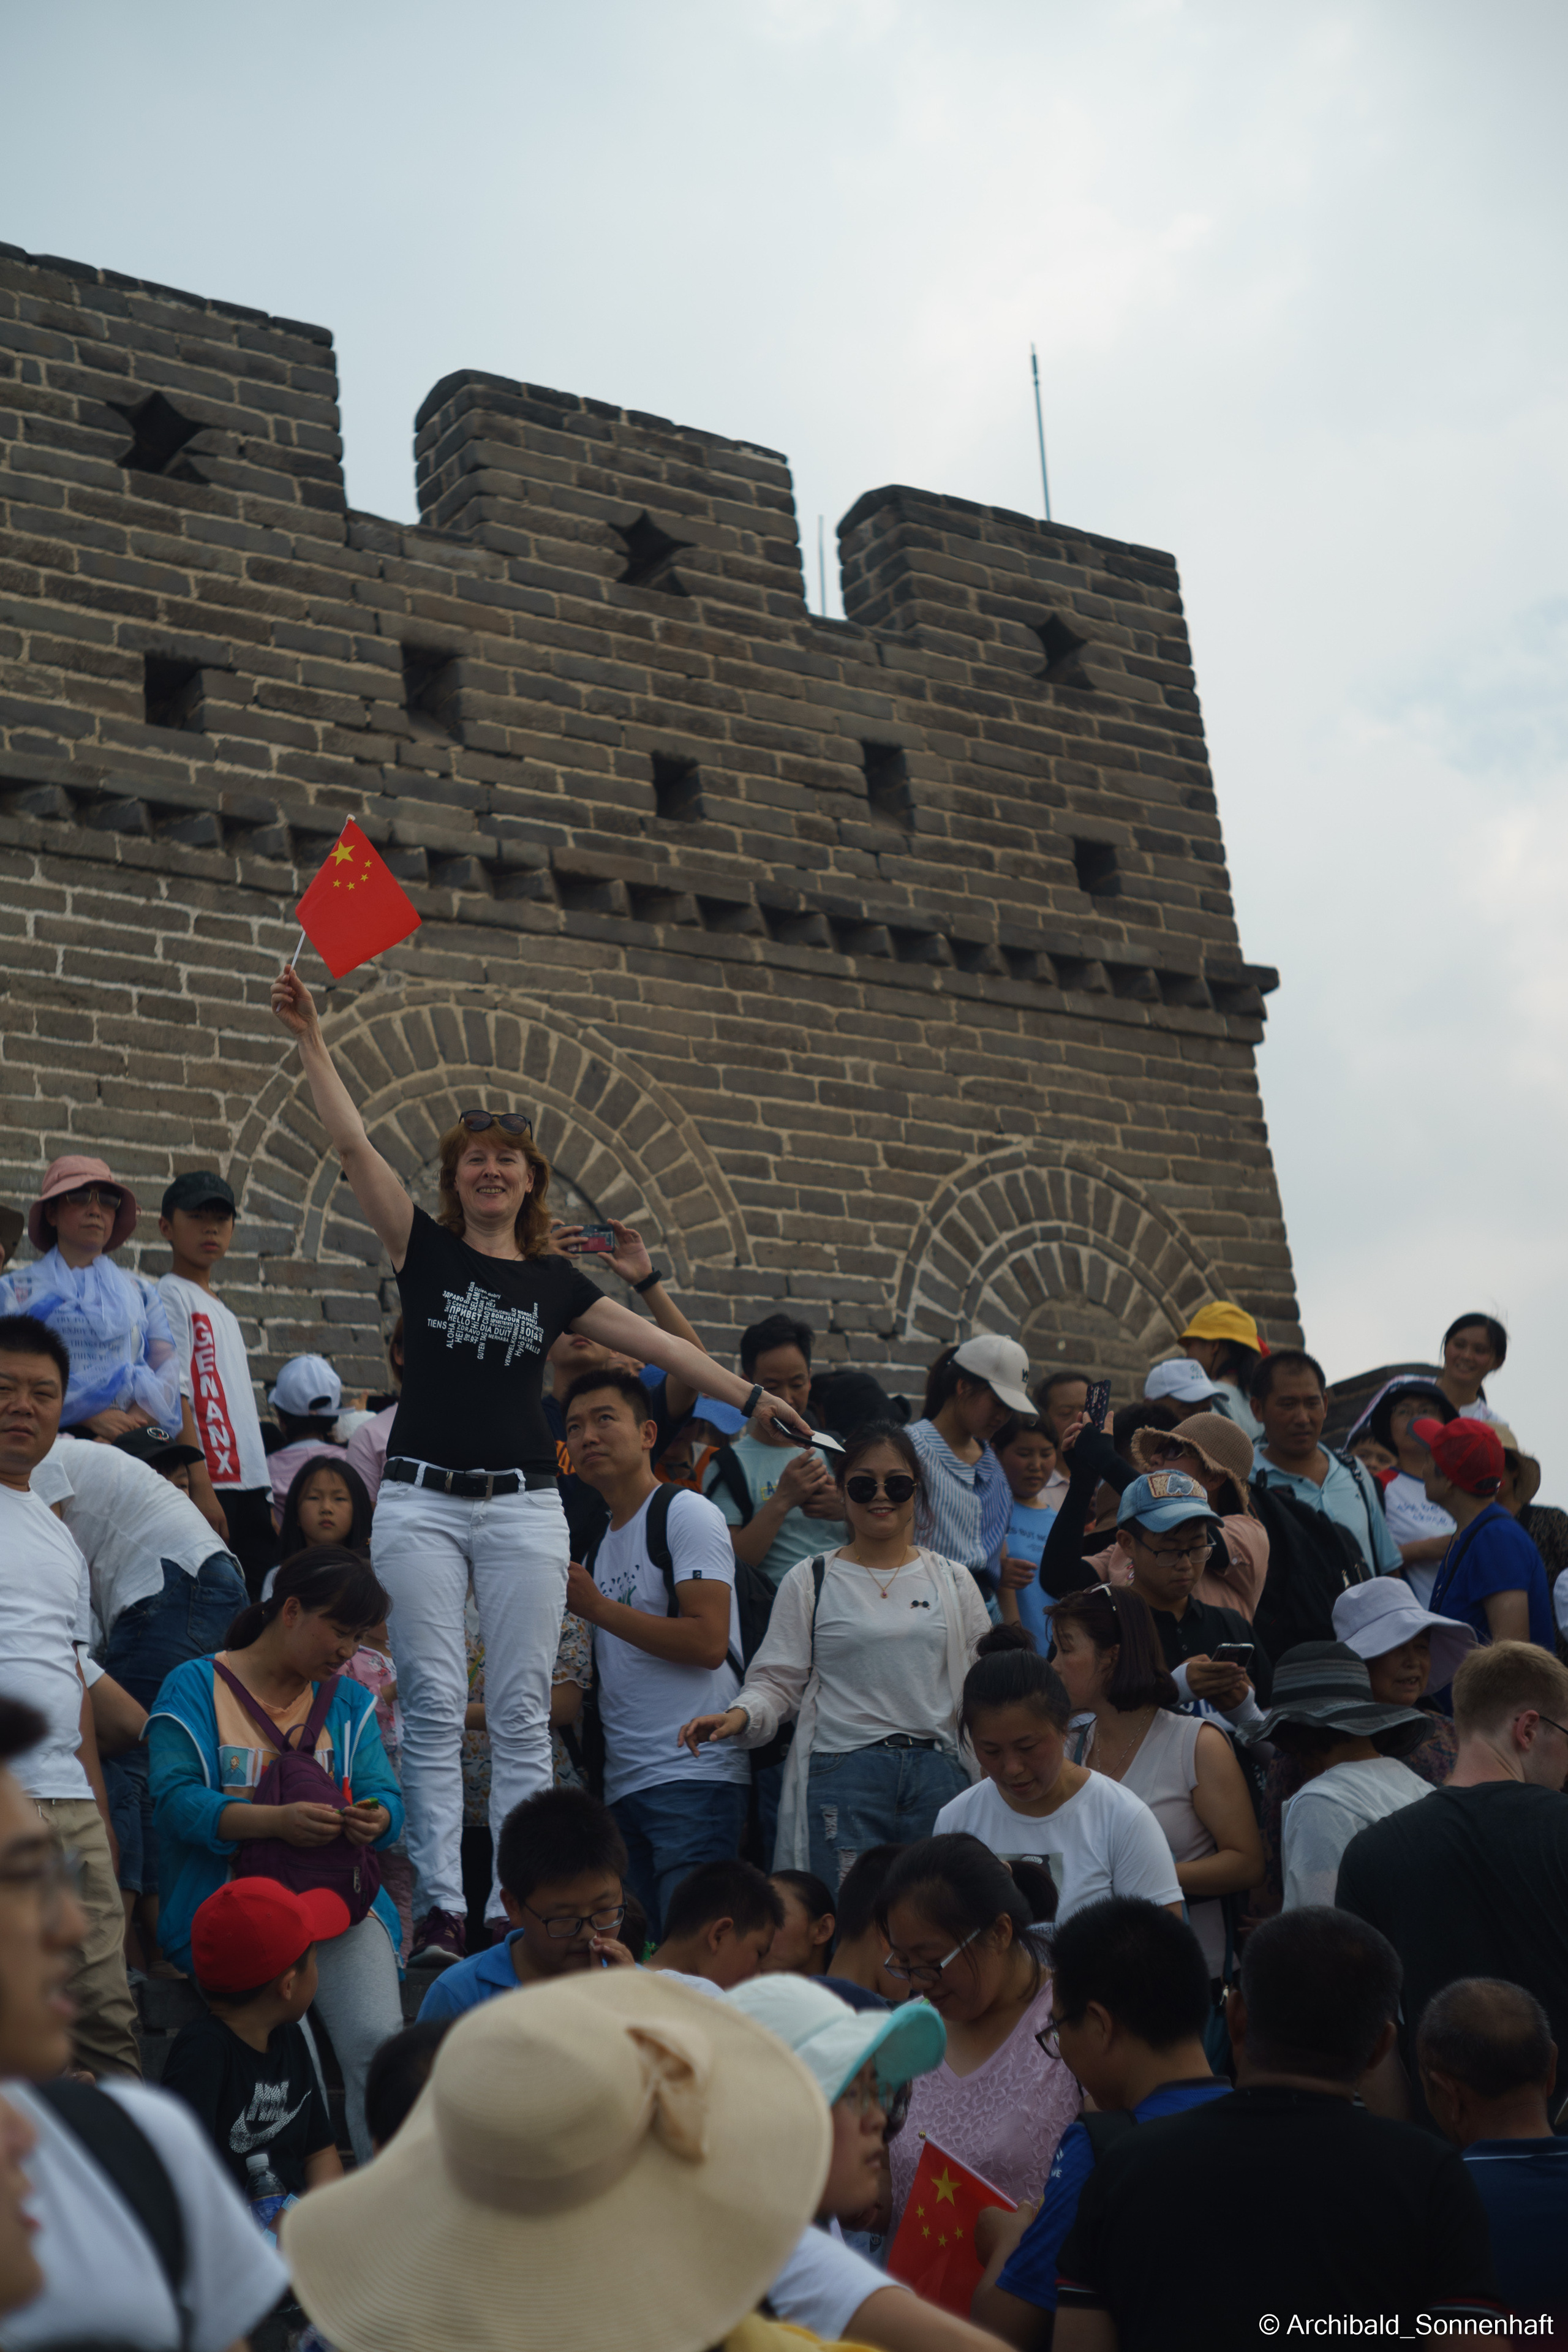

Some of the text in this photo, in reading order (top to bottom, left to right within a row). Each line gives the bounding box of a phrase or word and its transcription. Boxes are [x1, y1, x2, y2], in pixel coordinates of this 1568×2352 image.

[442, 1291, 464, 1302] ЗДРАВО
[470, 1291, 481, 1311] SELAM
[448, 1314, 470, 1325] HELLO
[450, 1306, 481, 1322] ПРИВЕТ
[482, 1311, 491, 1324] CIAO
[491, 1313, 519, 1323] BONJOUR
[518, 1314, 537, 1325] SANNU
[428, 1319, 447, 1330] TIENS
[457, 1324, 480, 1336] ZDRAVO
[471, 1321, 478, 1329] Hi
[480, 1324, 512, 1337] DIA DUIT
[526, 1322, 543, 1334] PRONTO
[447, 1323, 455, 1349] ALOHA
[463, 1333, 478, 1344] 您好
[488, 1334, 509, 1343] MERHABA
[519, 1335, 533, 1344] SALVE
[525, 1328, 538, 1340] Olá
[505, 1323, 519, 1366] VERWELKOMING
[525, 1343, 540, 1355] HALLO
[194, 1321, 234, 1475] GENANX
